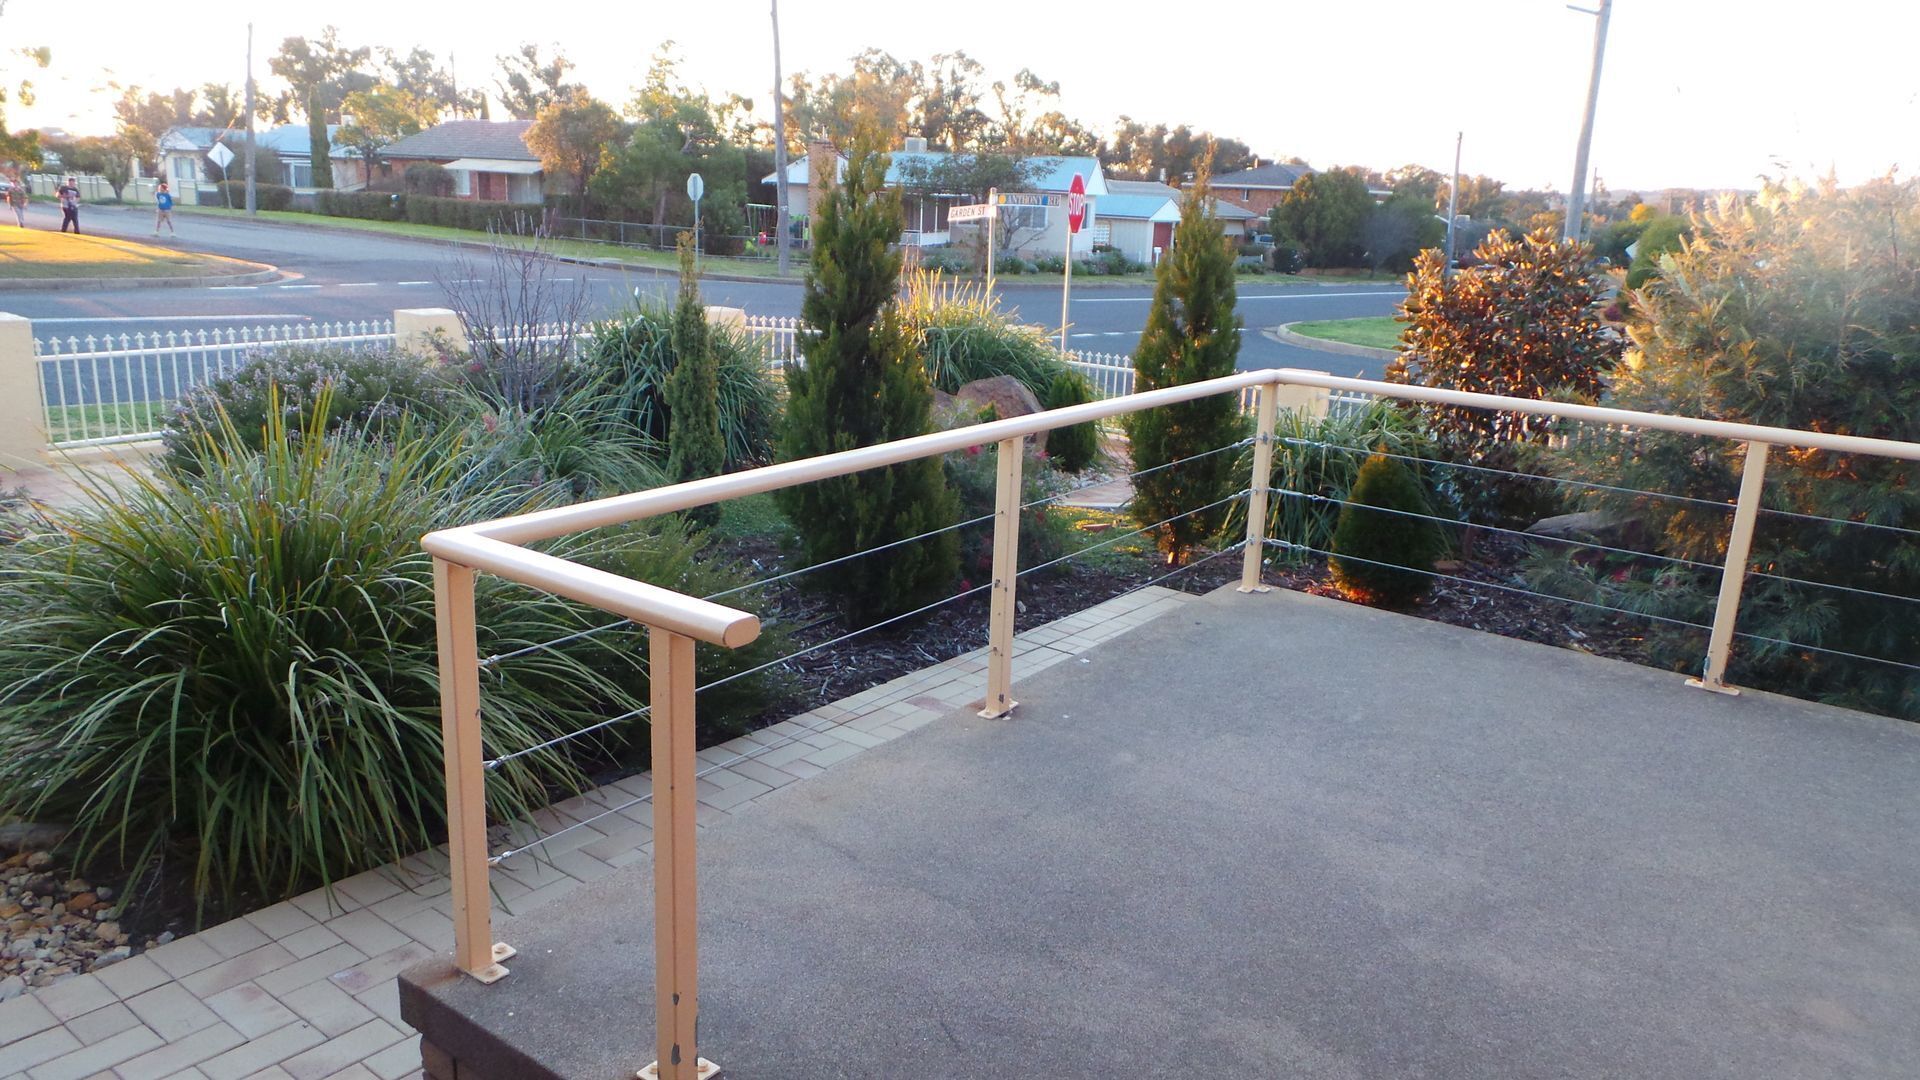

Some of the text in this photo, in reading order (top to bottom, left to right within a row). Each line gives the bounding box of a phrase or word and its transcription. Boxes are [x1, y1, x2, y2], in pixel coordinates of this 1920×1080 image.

[1007, 195, 1059, 206] ANTHONY RD
[1069, 193, 1083, 216] STOP
[951, 205, 985, 218] GARDEN ST
